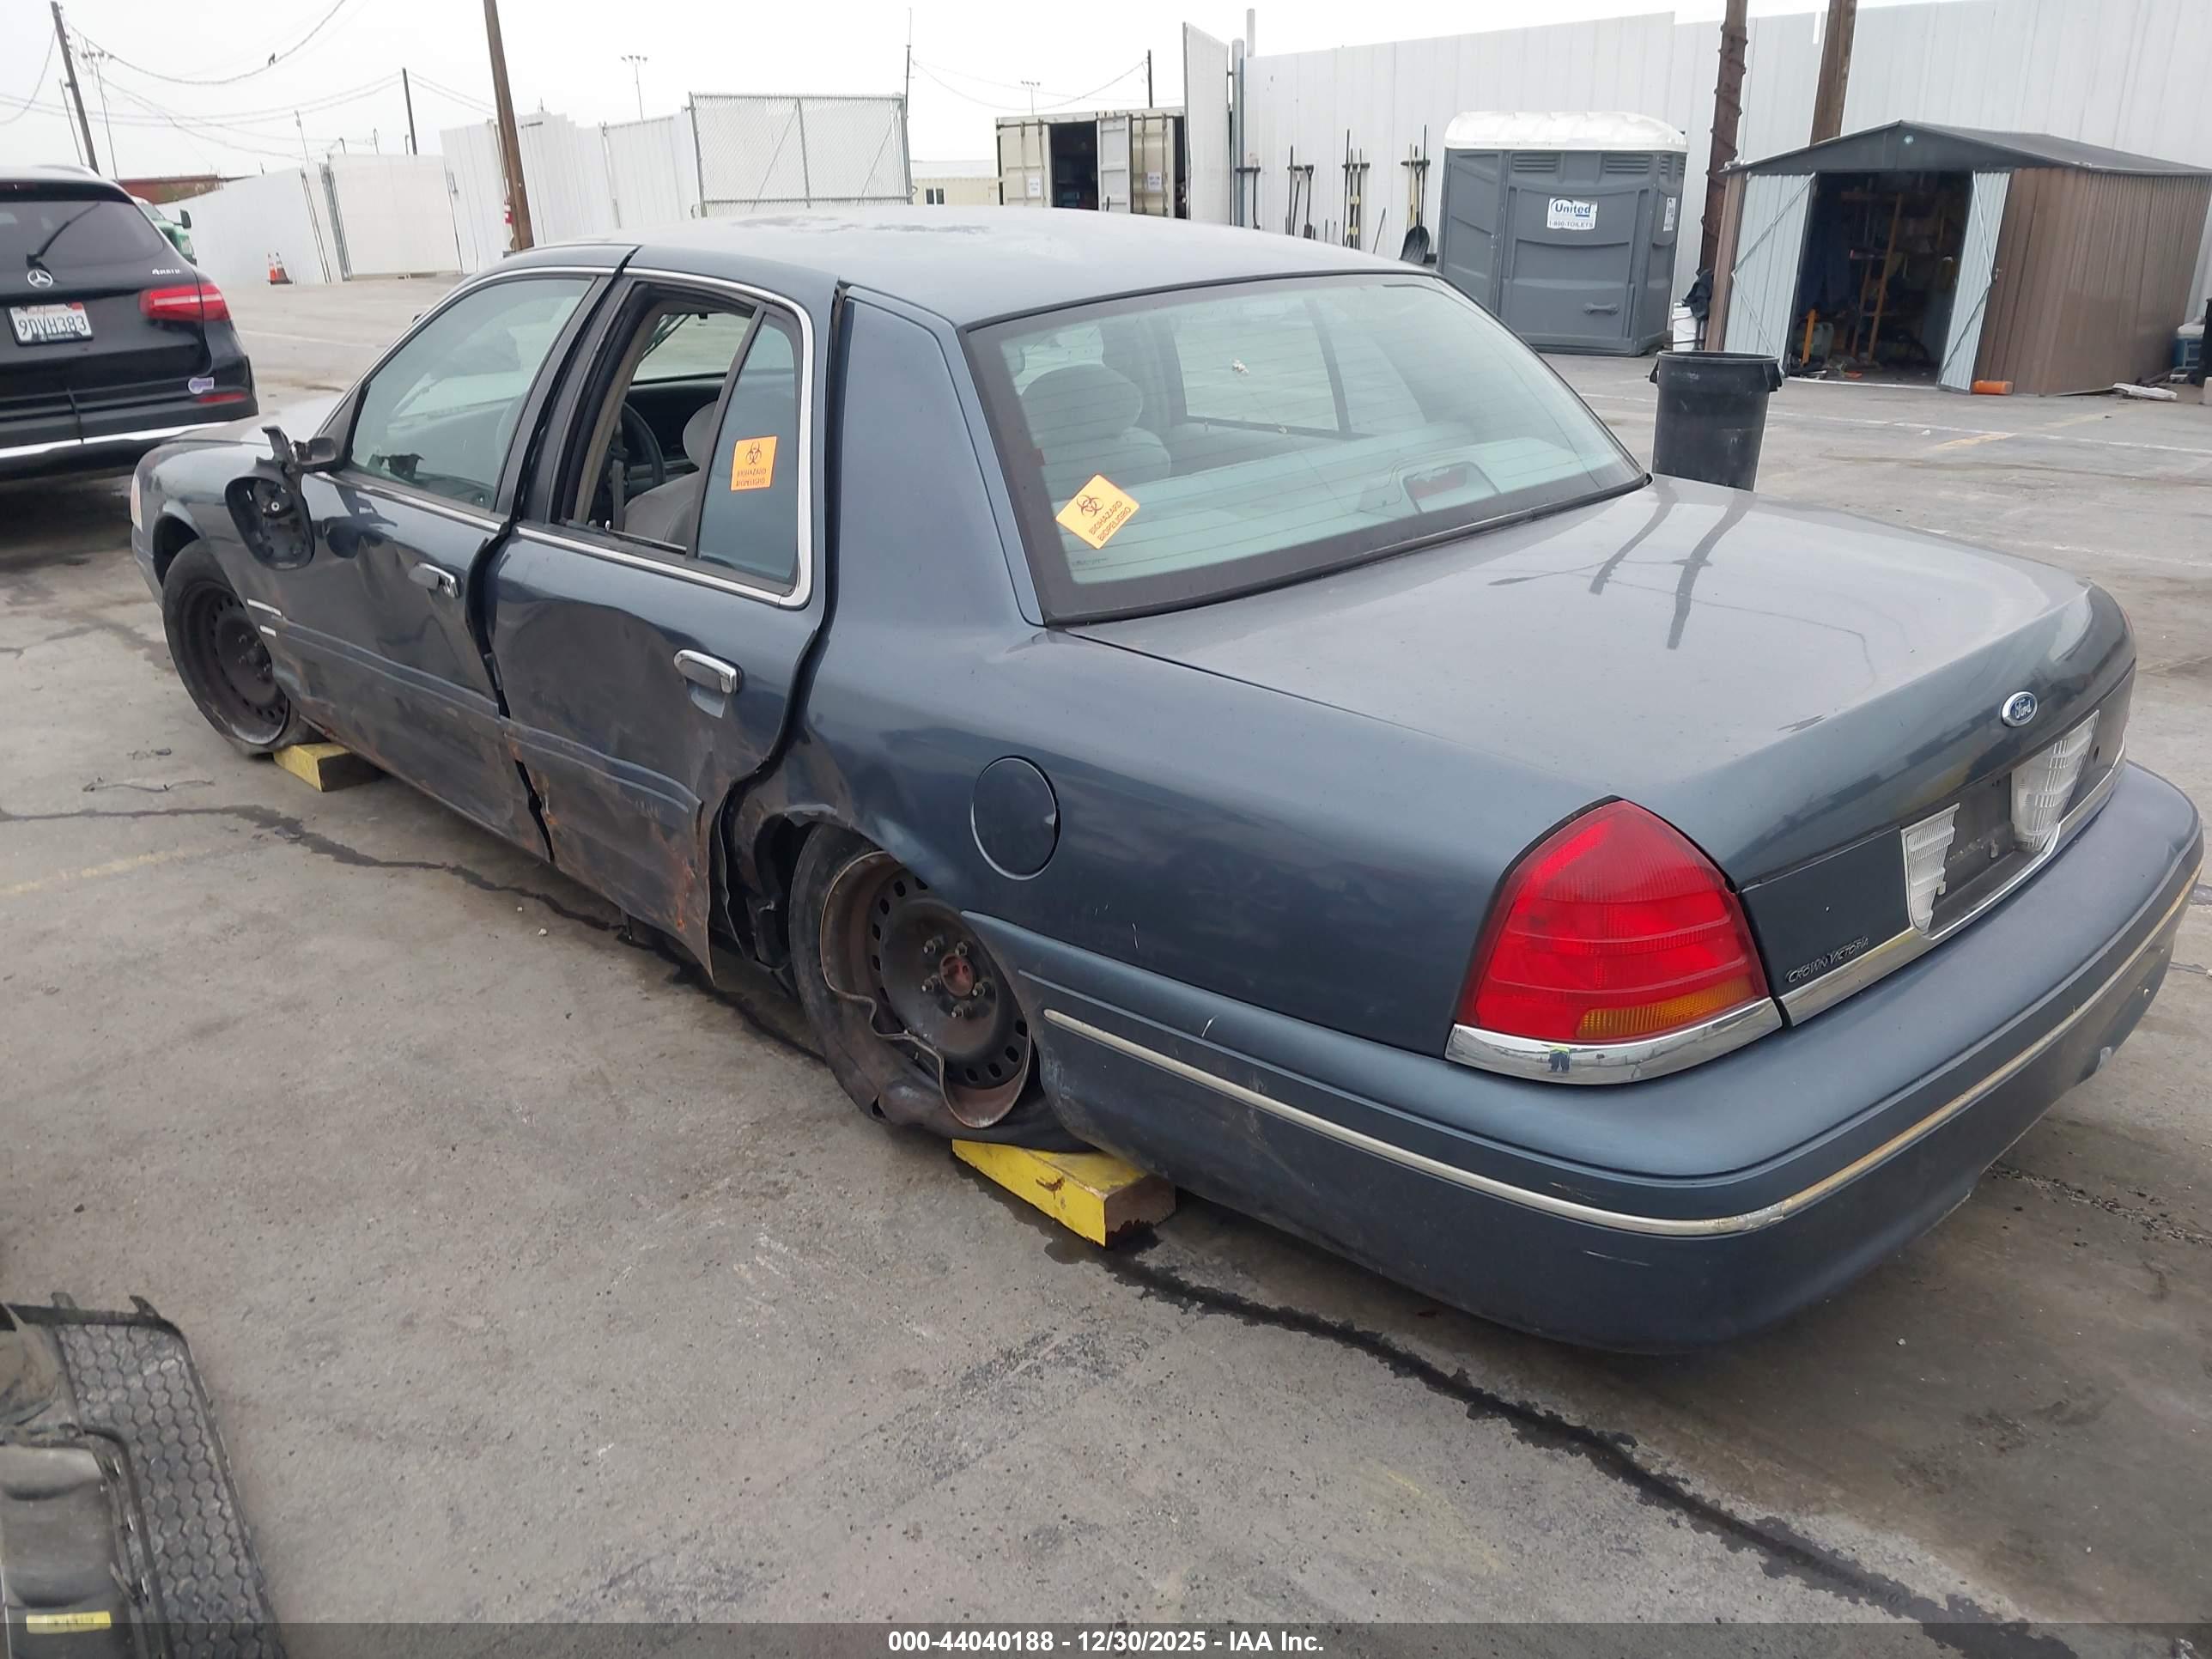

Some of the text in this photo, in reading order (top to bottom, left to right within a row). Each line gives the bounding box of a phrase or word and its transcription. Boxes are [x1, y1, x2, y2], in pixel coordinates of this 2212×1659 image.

[1555, 203, 1591, 214] United
[1088, 500, 1123, 535] BIOHAZARD
[2014, 698, 2032, 720] Ford
[1787, 956, 1828, 983] CROWN
